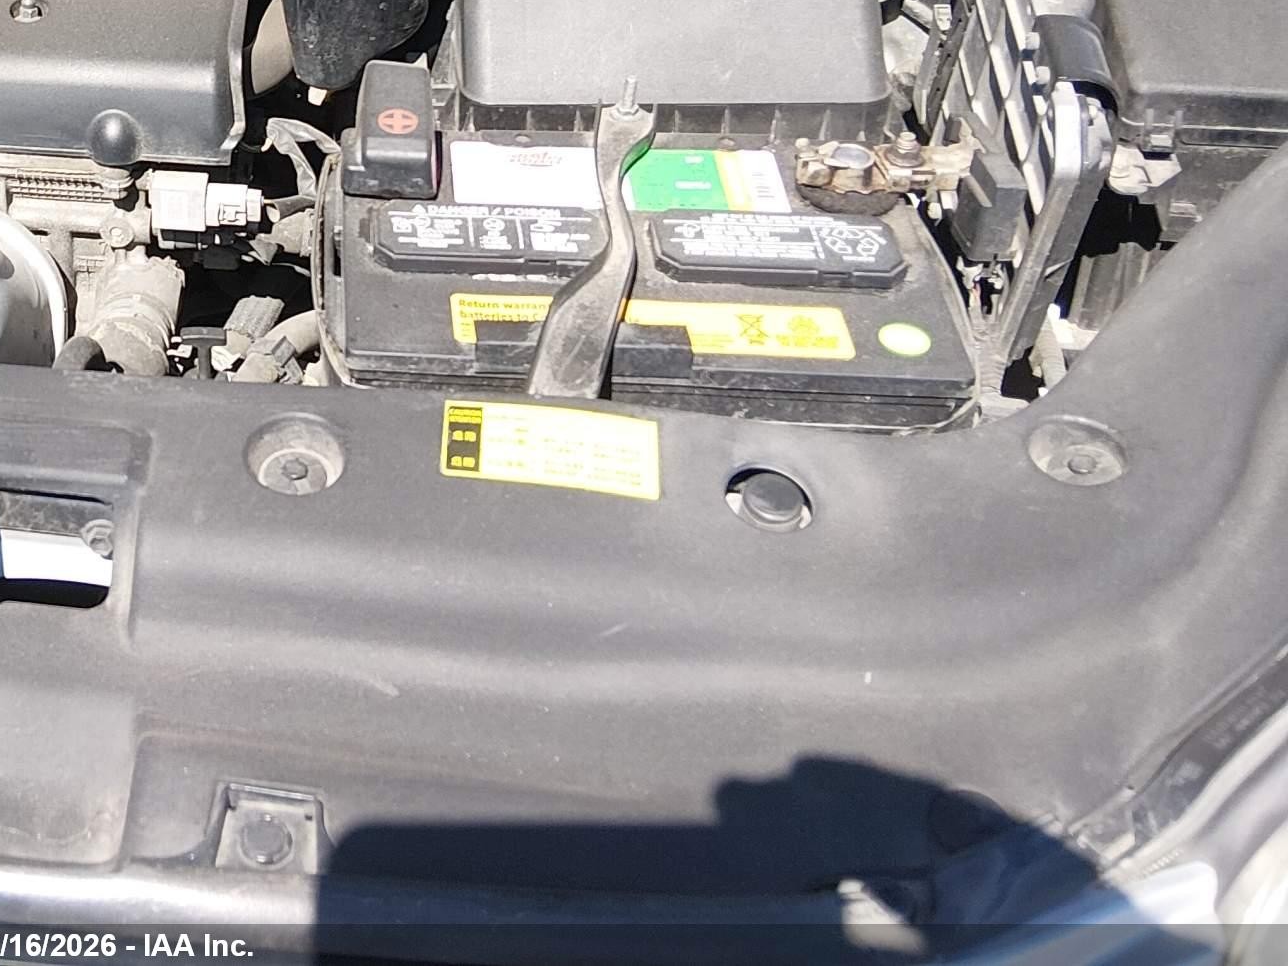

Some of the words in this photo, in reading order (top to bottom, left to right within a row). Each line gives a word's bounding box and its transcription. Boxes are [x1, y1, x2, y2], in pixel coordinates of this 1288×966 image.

[426, 204, 490, 216] DANGER
[503, 207, 561, 219] POISON
[458, 298, 500, 309] Return
